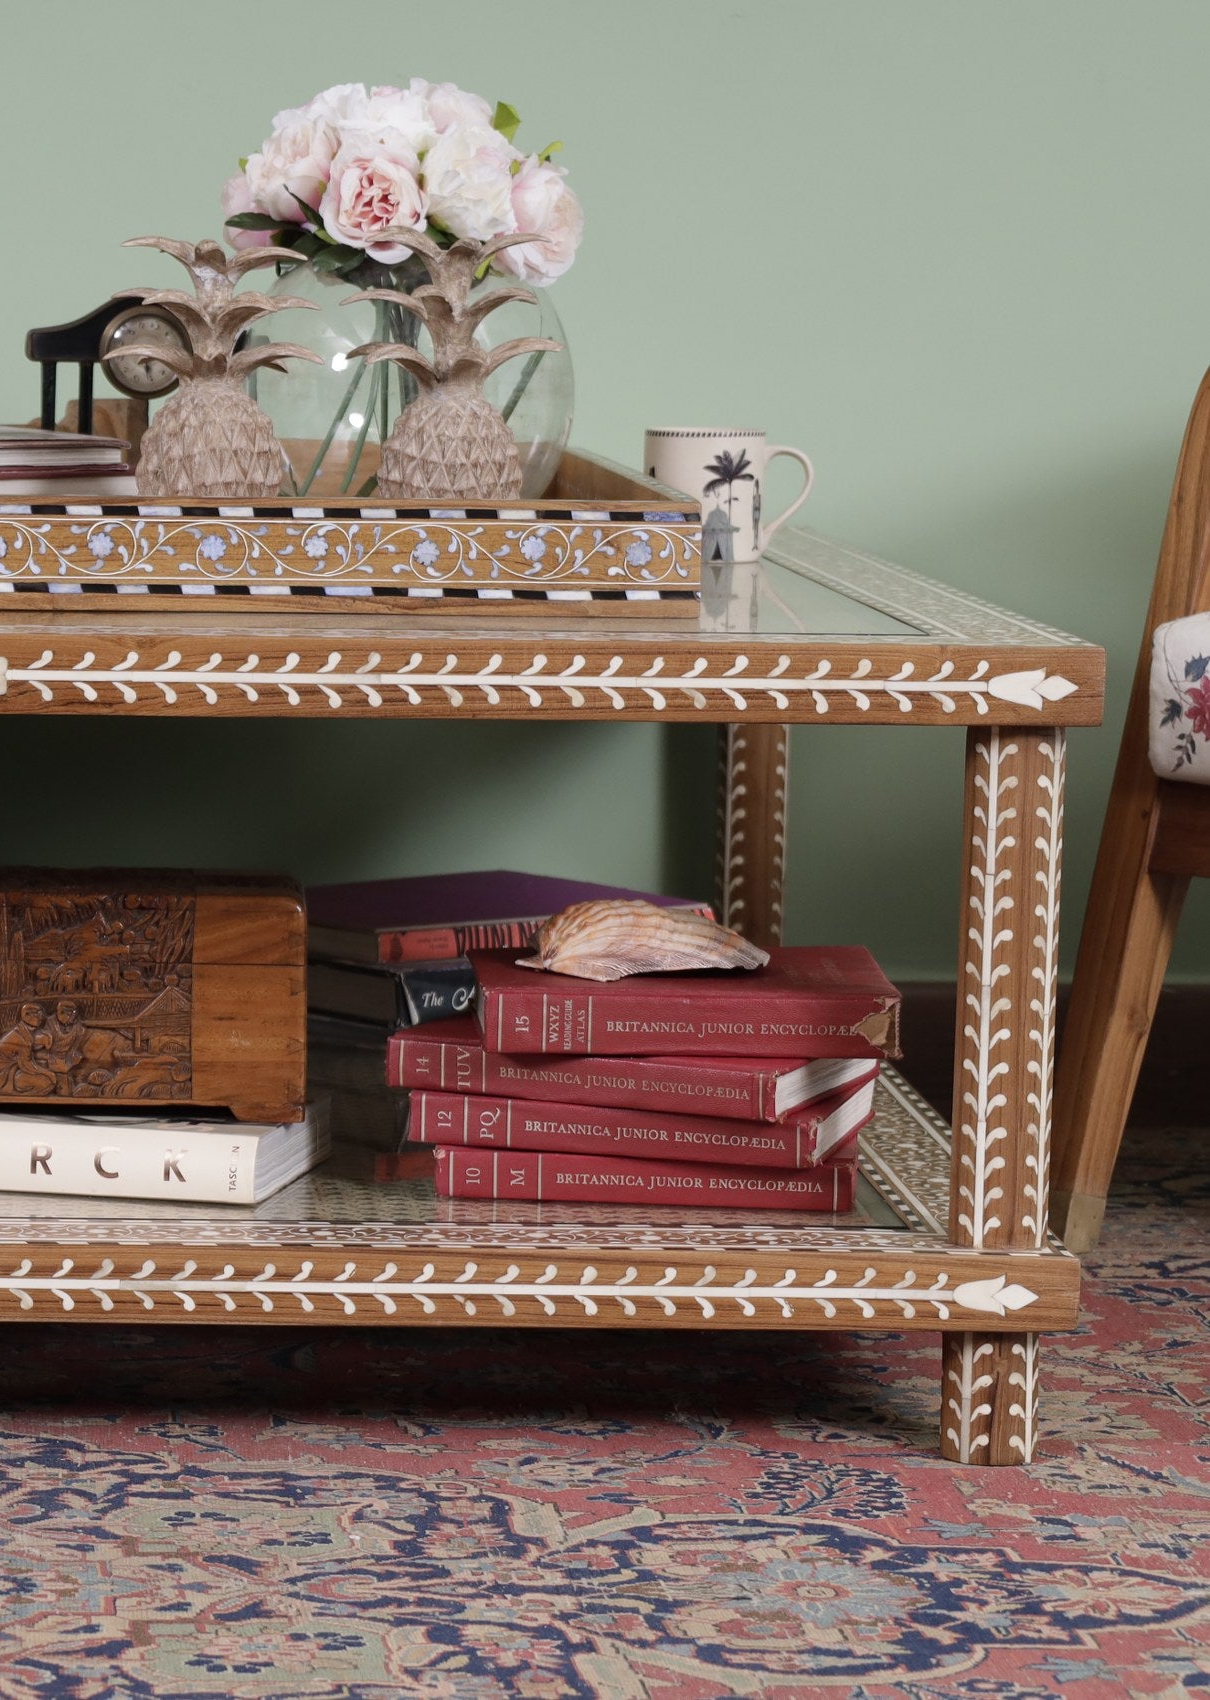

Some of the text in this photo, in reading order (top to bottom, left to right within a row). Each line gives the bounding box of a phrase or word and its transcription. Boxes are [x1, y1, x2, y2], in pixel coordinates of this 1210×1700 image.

[422, 991, 444, 1008] The
[515, 1015, 530, 1033] 15
[549, 1005, 560, 1043] WXYZ
[563, 999, 573, 1050] READING GUIDE
[576, 1009, 586, 1043] ATLAS
[606, 1021, 696, 1036] BRITANNICA
[698, 1022, 755, 1037] JUNIOR
[415, 1056, 430, 1073] 14
[457, 1045, 471, 1090] TUV
[499, 1066, 750, 1100] BRITANNICA JUNIOR ENCYCLOPÆDIA
[437, 1110, 452, 1128] 12
[480, 1107, 501, 1139] PQ
[524, 1120, 786, 1150] BRITANNICA JUNIOR ENCYCLOPÆDIA
[228, 1146, 240, 1192] TASCN
[465, 1167, 481, 1184] 10
[510, 1168, 525, 1186] M
[556, 1173, 823, 1193] BRITANNICA JUNIOR ENCYCLOPÆDIA
